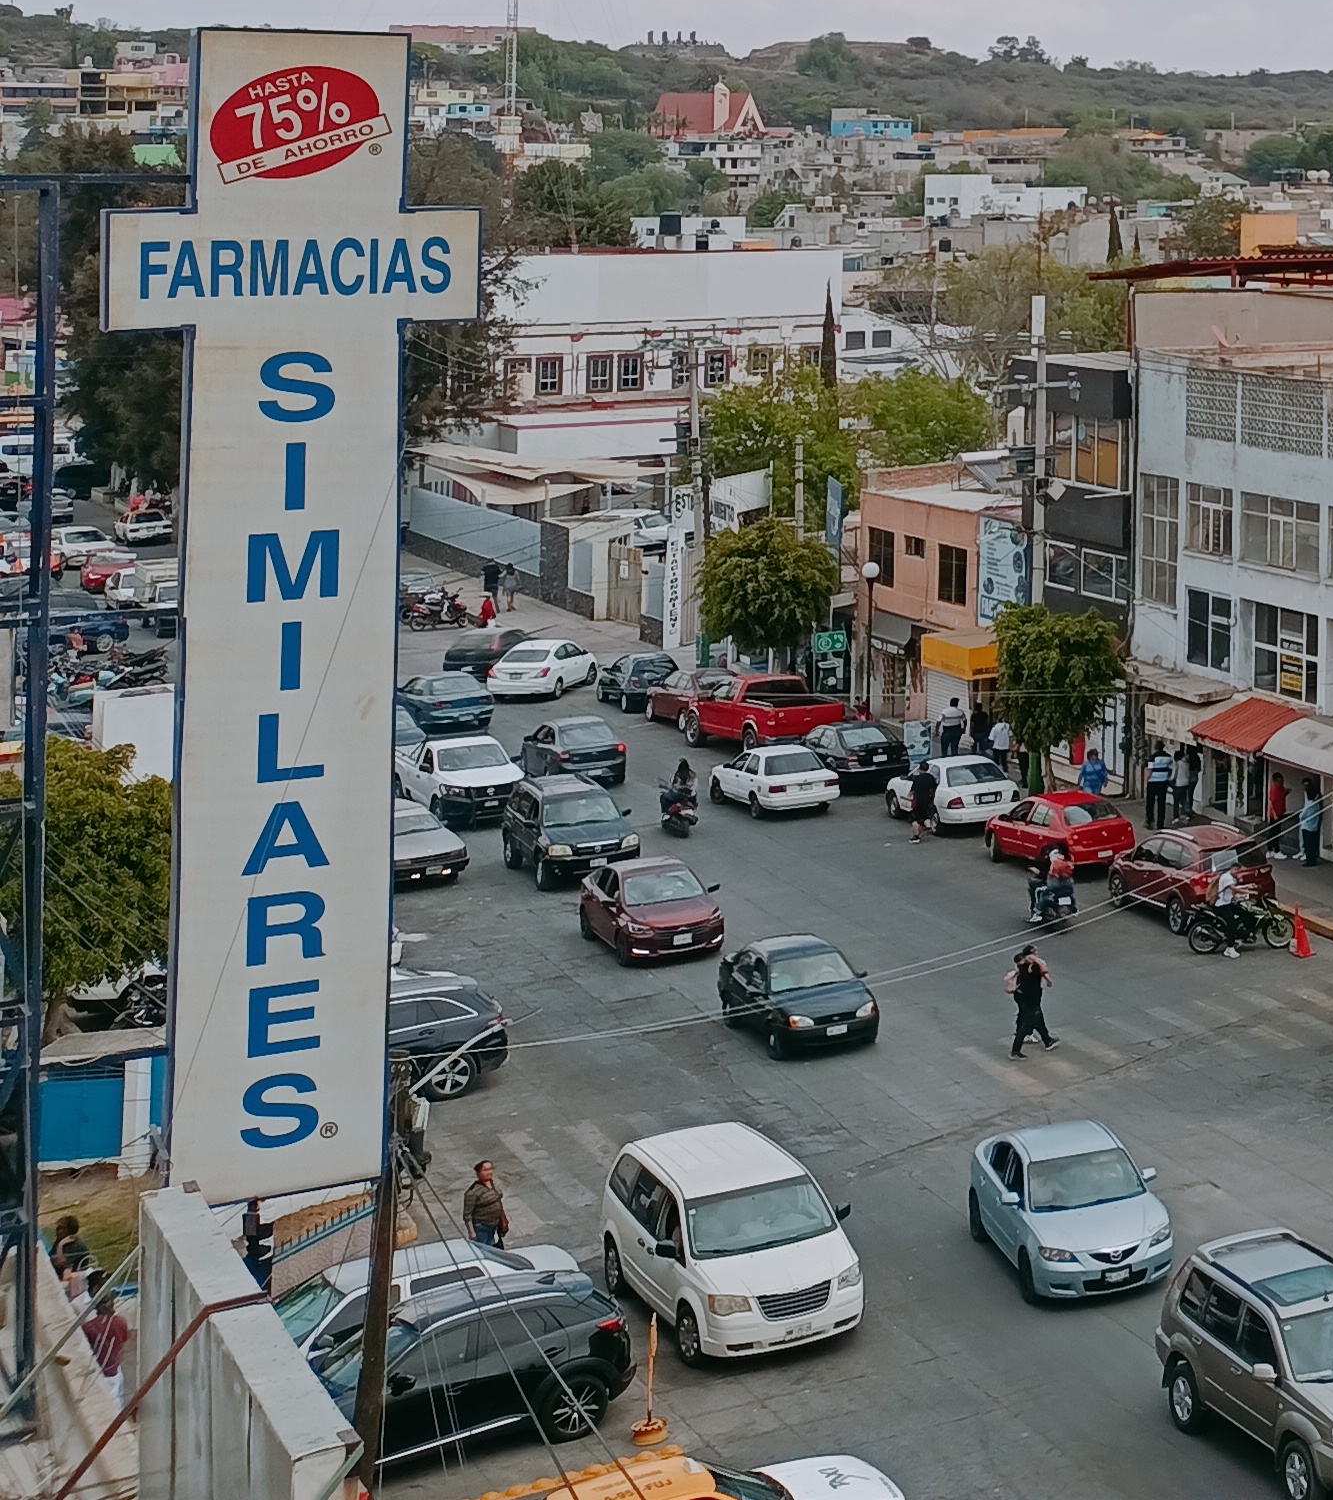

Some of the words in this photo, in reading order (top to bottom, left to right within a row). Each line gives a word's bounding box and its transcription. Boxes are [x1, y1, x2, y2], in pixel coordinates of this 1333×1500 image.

[234, 81, 350, 150] 75%
[248, 71, 314, 99] HASTA
[236, 156, 267, 175] DE
[284, 124, 374, 161] AHORRO
[139, 236, 452, 300] FARMACIAS
[240, 350, 340, 1148] SIMILARES
